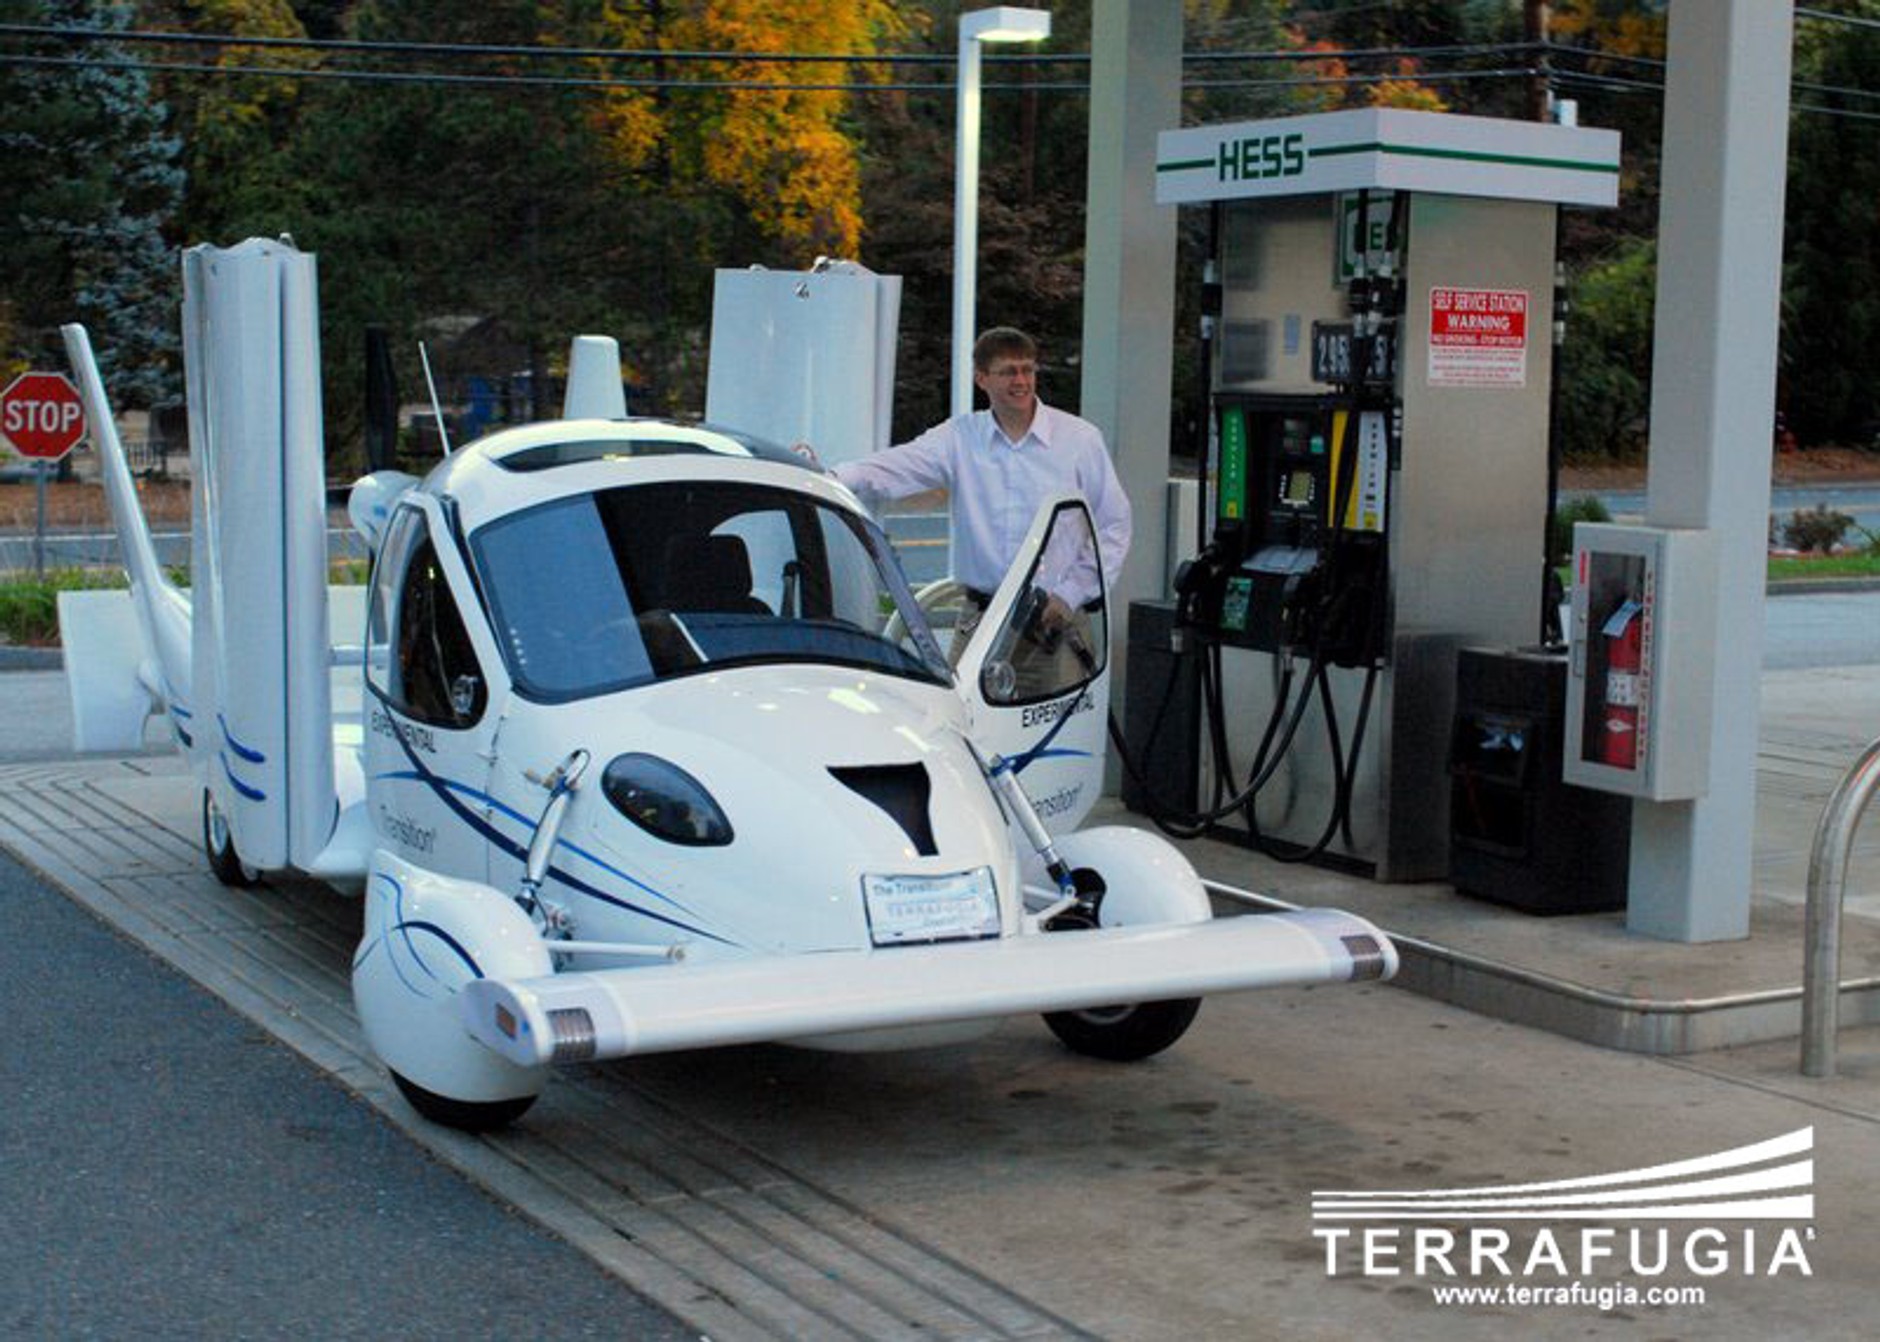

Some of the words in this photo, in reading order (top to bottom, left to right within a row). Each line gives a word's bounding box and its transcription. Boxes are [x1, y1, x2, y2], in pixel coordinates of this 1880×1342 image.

[1219, 133, 1303, 181] HESS
[1447, 314, 1510, 330] WARNING
[5, 400, 81, 433] STOP
[371, 709, 437, 753] EXPEENTAL
